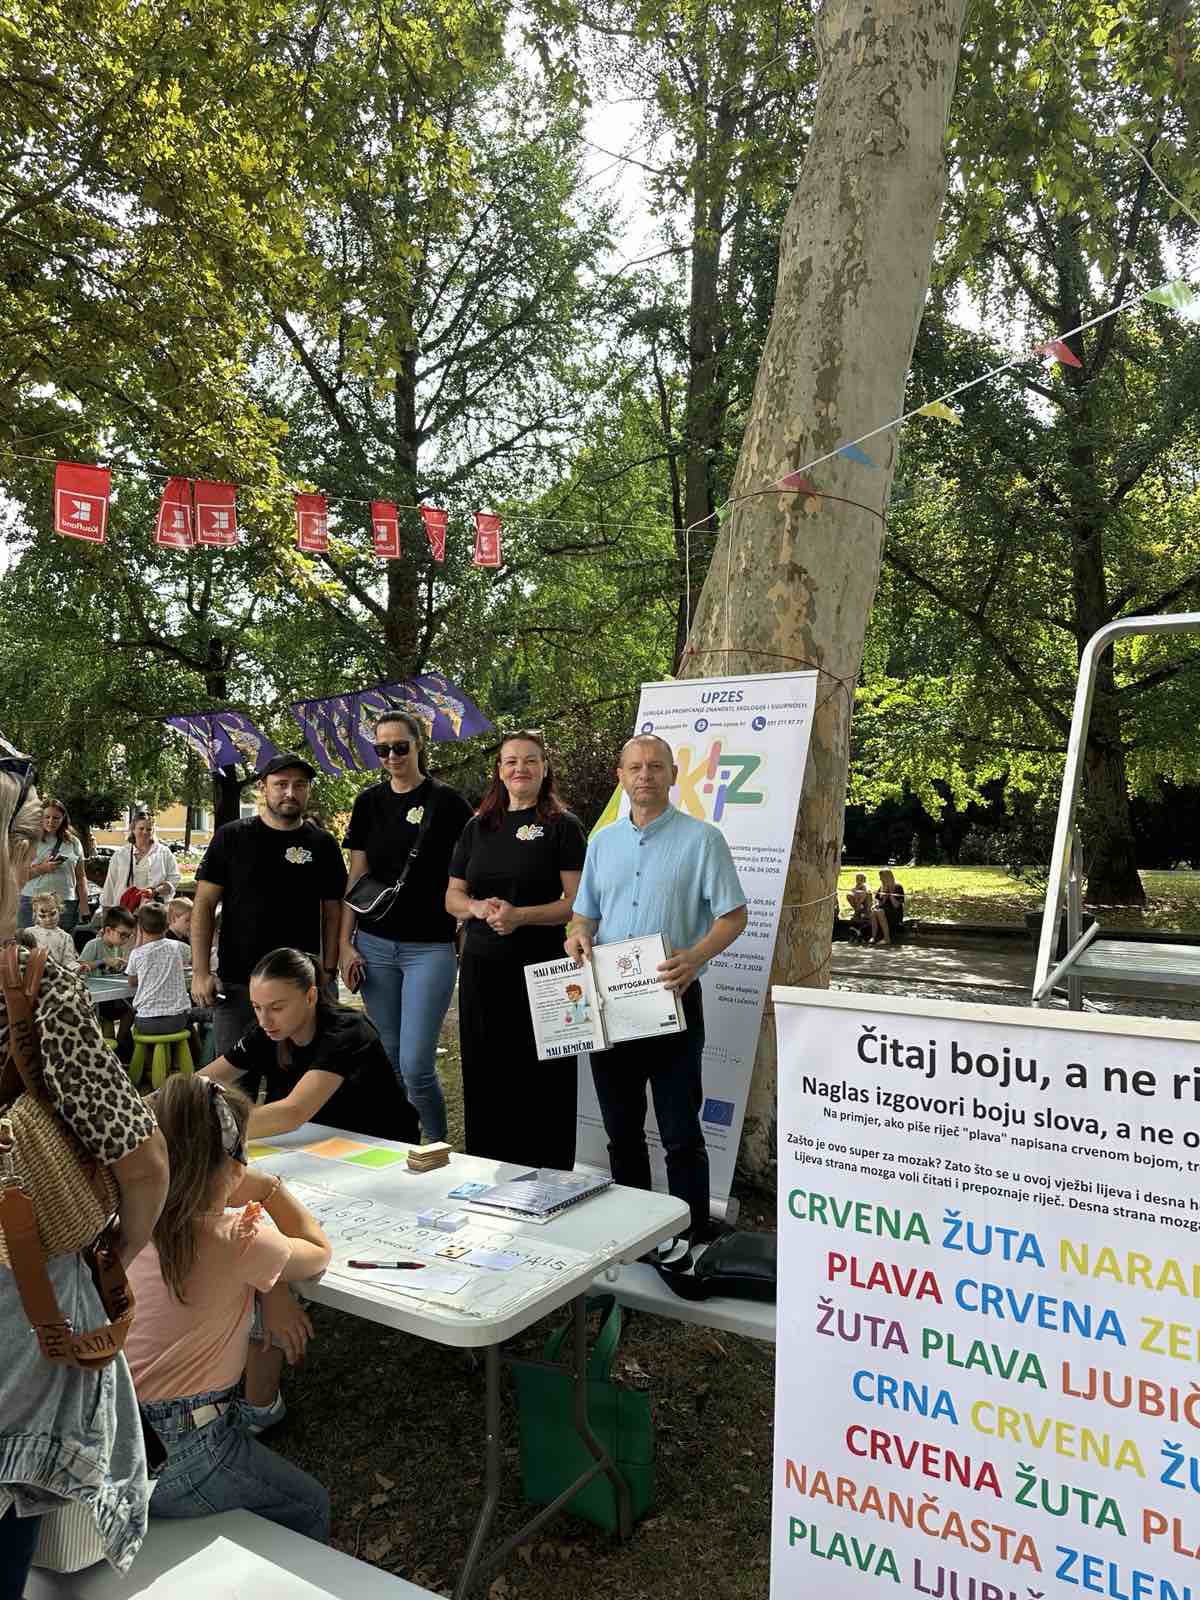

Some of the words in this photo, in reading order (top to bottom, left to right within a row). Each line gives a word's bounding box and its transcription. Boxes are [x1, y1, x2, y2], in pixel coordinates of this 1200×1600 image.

[701, 690, 744, 704] UPZES
[534, 968, 548, 977] MALI
[550, 961, 578, 974] KEMIČAR
[608, 978, 657, 992] KRIPTOGRAFIJ
[546, 1047, 562, 1056] MALI
[563, 1041, 593, 1054] KEMIČARI
[857, 1025, 937, 1077] Čitaj
[951, 1040, 1050, 1091] boju,
[1065, 1062, 1087, 1089] a
[1104, 1066, 1156, 1097] ne
[803, 1075, 870, 1104] Naglas
[876, 1086, 965, 1118] izgovori
[973, 1098, 1026, 1127] boju
[1034, 1108, 1107, 1140] slova,
[1116, 1119, 1131, 1140] a
[1140, 1125, 1174, 1145] ne
[823, 1106, 838, 1120] Na
[840, 1110, 882, 1128] primjer,
[884, 1117, 904, 1130] ako
[908, 1117, 931, 1135] piše
[933, 1120, 960, 1139] riječ
[962, 1126, 1008, 1145] "plava"
[1011, 1137, 1068, 1155] napisana
[1071, 1143, 1129, 1162] crvenom
[1134, 1151, 1183, 1173] bojom,
[1187, 1159, 1200, 1174] tr
[787, 1133, 814, 1149] Zašto
[815, 1137, 825, 1151] je
[828, 1142, 847, 1154] ovo
[849, 1145, 880, 1163] super
[882, 1151, 895, 1161] za
[898, 1153, 942, 1171] mozak?
[945, 1159, 971, 1174] Zato
[974, 1161, 993, 1178] što
[996, 1168, 1009, 1180] se
[1012, 1171, 1021, 1182] u
[1024, 1172, 1051, 1190] ovoj
[1055, 1174, 1093, 1194] vježbi
[1097, 1181, 1132, 1202] lijeva
[1135, 1187, 1140, 1199] i
[1144, 1190, 1186, 1210] desna
[1190, 1199, 1200, 1212] h
[794, 1150, 823, 1166] Lijeva
[825, 1157, 857, 1173] strana
[861, 1163, 896, 1182] mozga
[899, 1169, 919, 1183] voli
[922, 1172, 952, 1189] čitati
[955, 1176, 959, 1188] i
[962, 1180, 1031, 1202] prepoznaje
[1033, 1188, 1065, 1209] riječ.
[1069, 1197, 1110, 1216] Desna
[1113, 1205, 1156, 1224] strana
[787, 1188, 931, 1245] CRVENA
[942, 1208, 1046, 1268] ŽUTA
[1059, 1239, 1200, 1299] NARA
[815, 1295, 909, 1354] ŽUTA
[922, 1328, 1048, 1390] PLAVA
[827, 1251, 944, 1305] PLAVA
[955, 1278, 1127, 1347] CRVENA
[1139, 1317, 1200, 1363] ZE
[852, 1369, 959, 1426] CRNA
[970, 1400, 1146, 1478] CRVENA
[784, 1458, 1042, 1573] NARANČASTA
[846, 1424, 1002, 1499] CRVENA
[1015, 1462, 1127, 1537] ŽUTA
[788, 1516, 901, 1584] PLAVA
[913, 1558, 1046, 1600] LJUB
